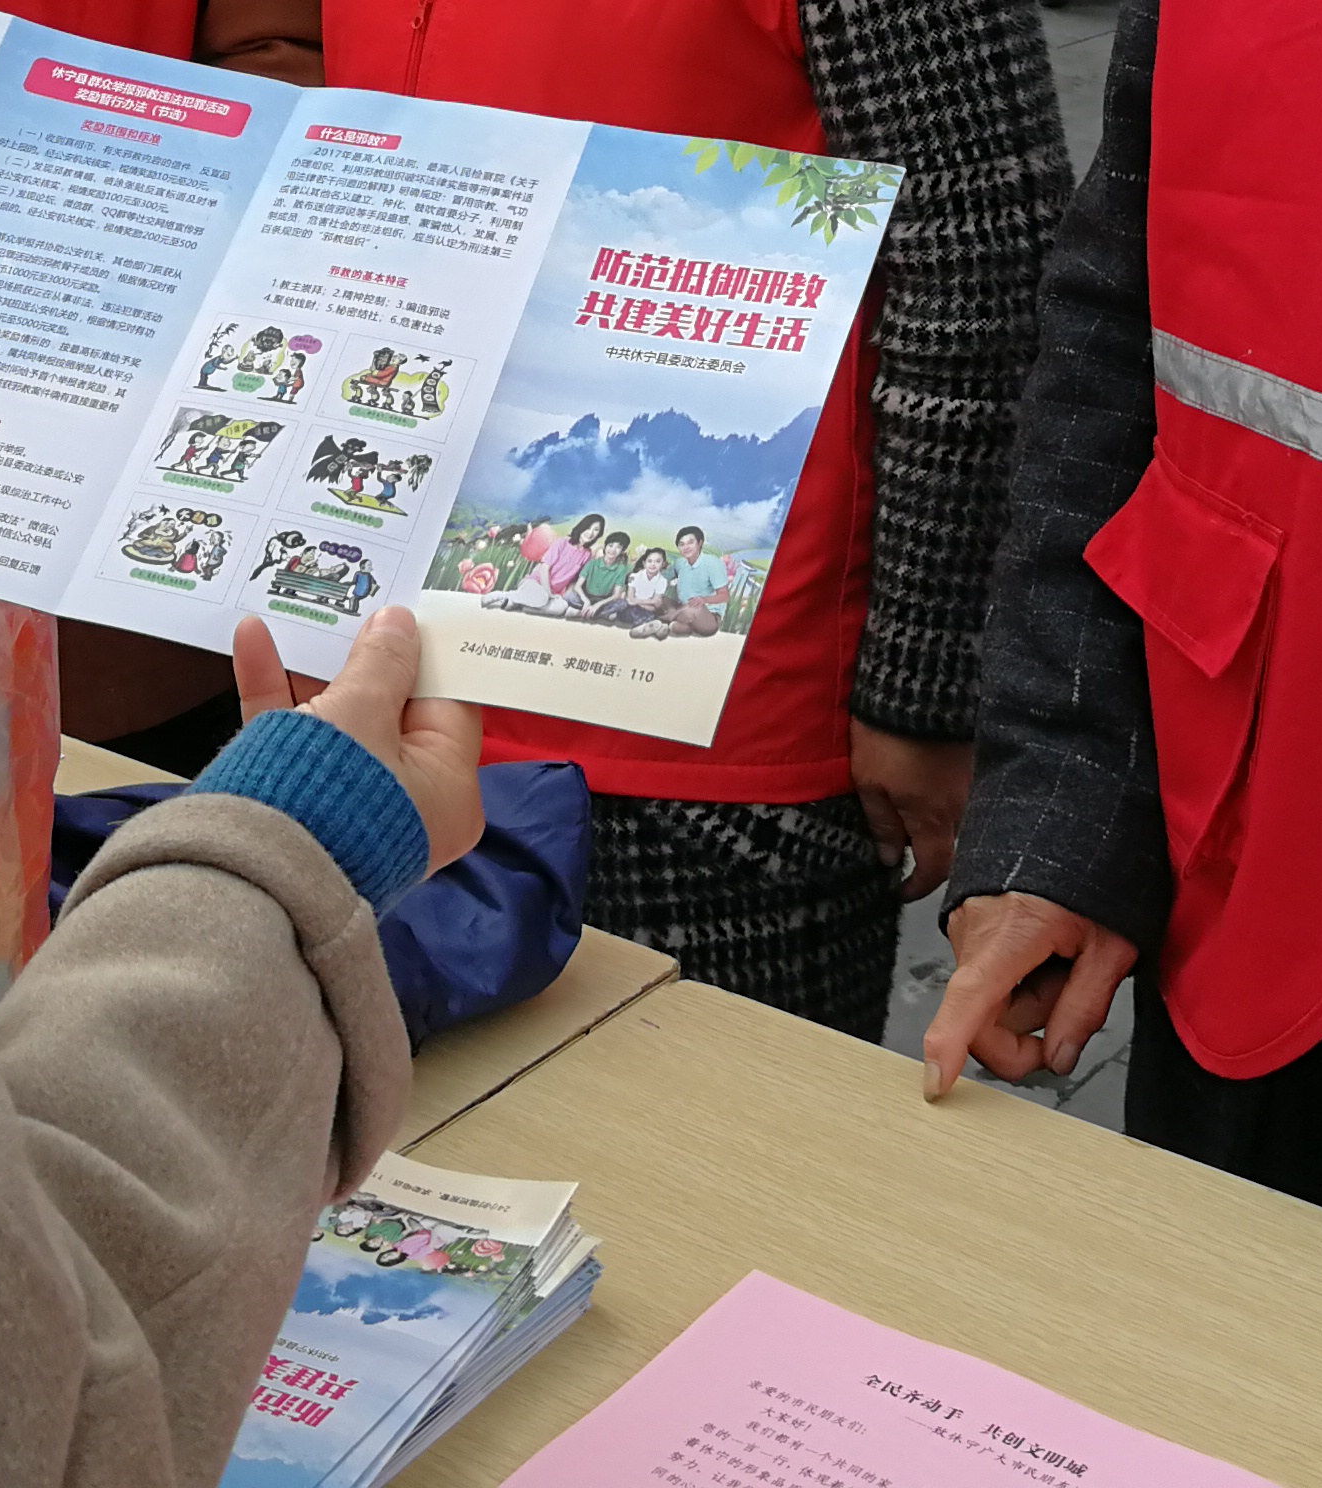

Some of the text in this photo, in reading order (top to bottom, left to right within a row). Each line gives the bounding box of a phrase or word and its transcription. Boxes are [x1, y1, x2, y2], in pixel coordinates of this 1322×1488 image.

[325, 265, 410, 288] 邪教的基本特征
[587, 245, 828, 311] 防范抵御邪教
[571, 289, 812, 355] 共建美好生活
[602, 343, 747, 376] 中共休宁县委政法委员会
[861, 1374, 1090, 1478] 全民齐动手 共创文明城
